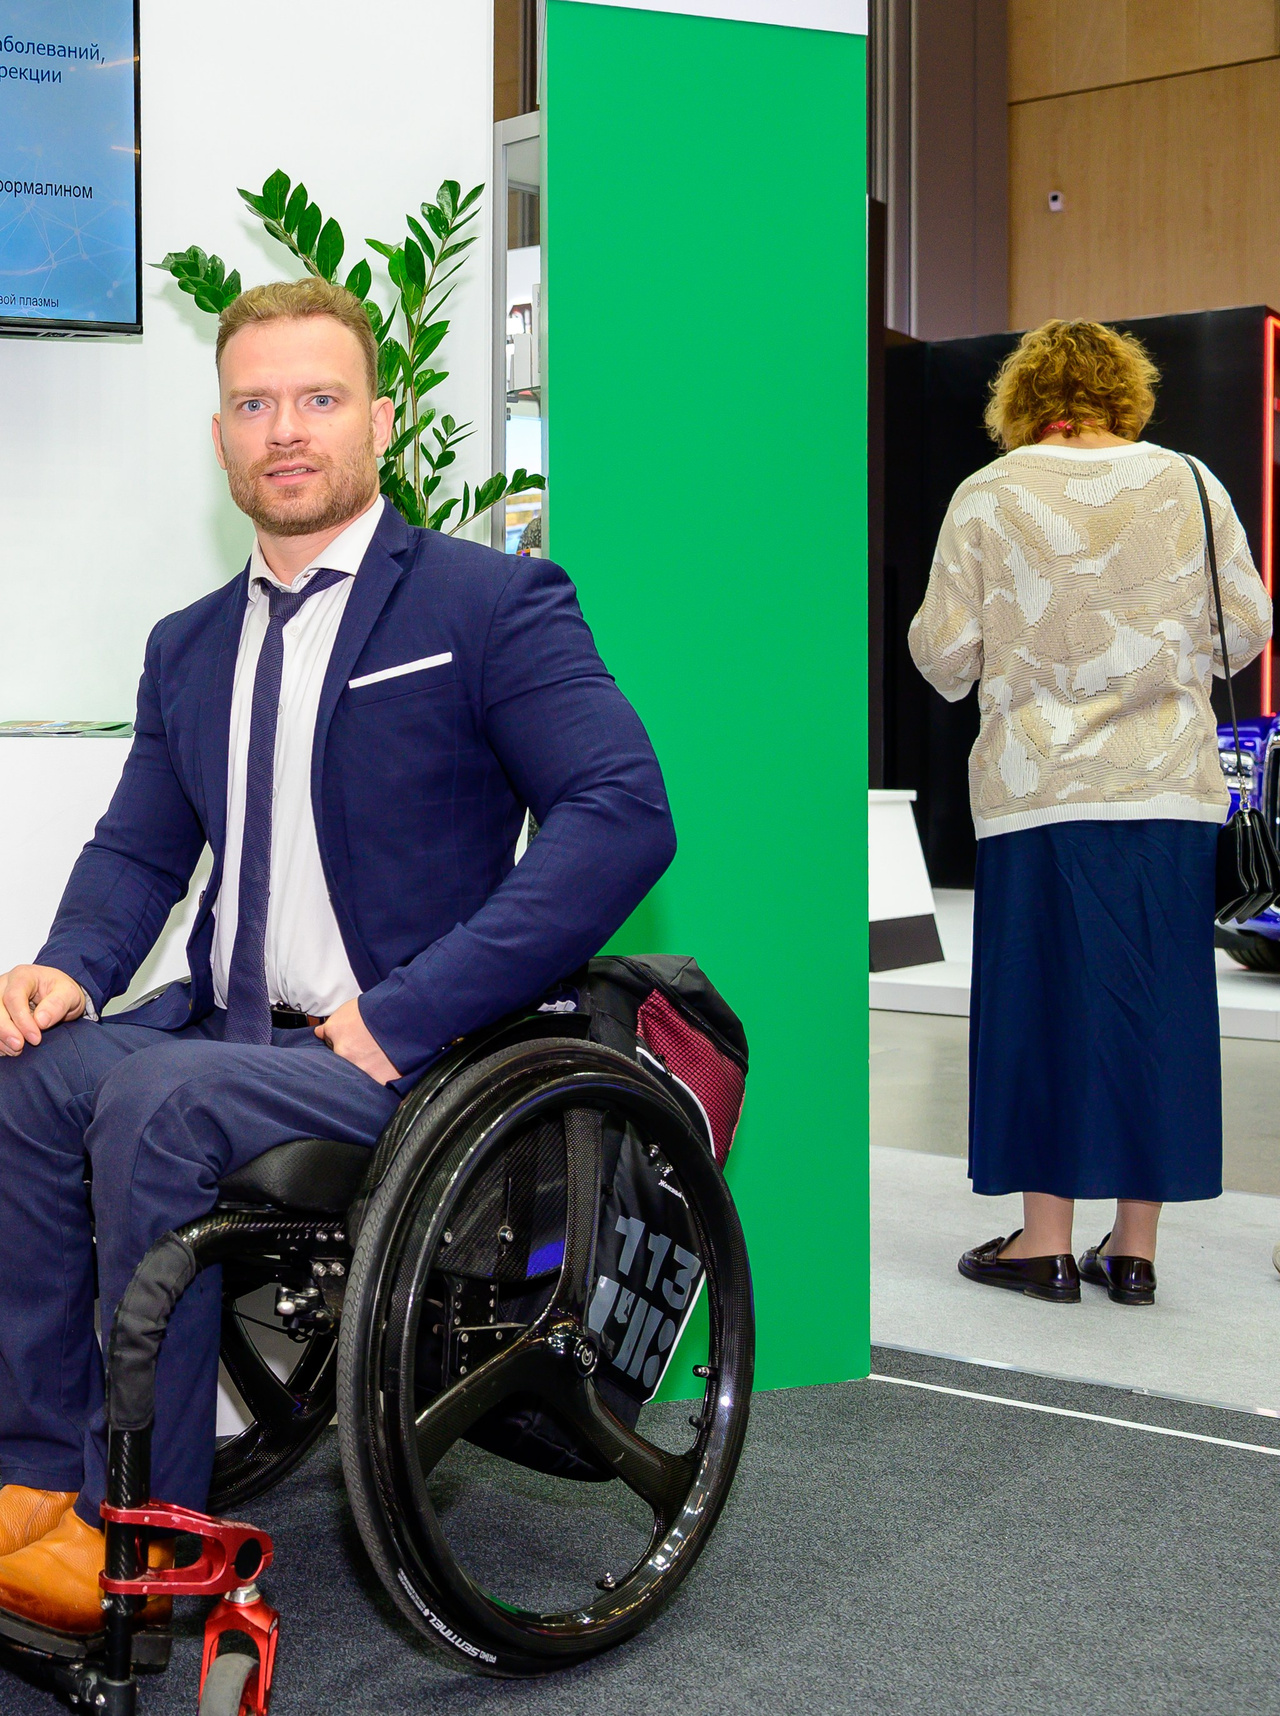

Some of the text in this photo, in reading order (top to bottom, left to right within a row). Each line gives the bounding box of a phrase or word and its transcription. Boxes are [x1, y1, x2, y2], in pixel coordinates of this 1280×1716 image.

[19, 296, 59, 308] плазмы
[615, 1215, 701, 1310] 113
[429, 1611, 480, 1657] SENTINEL
